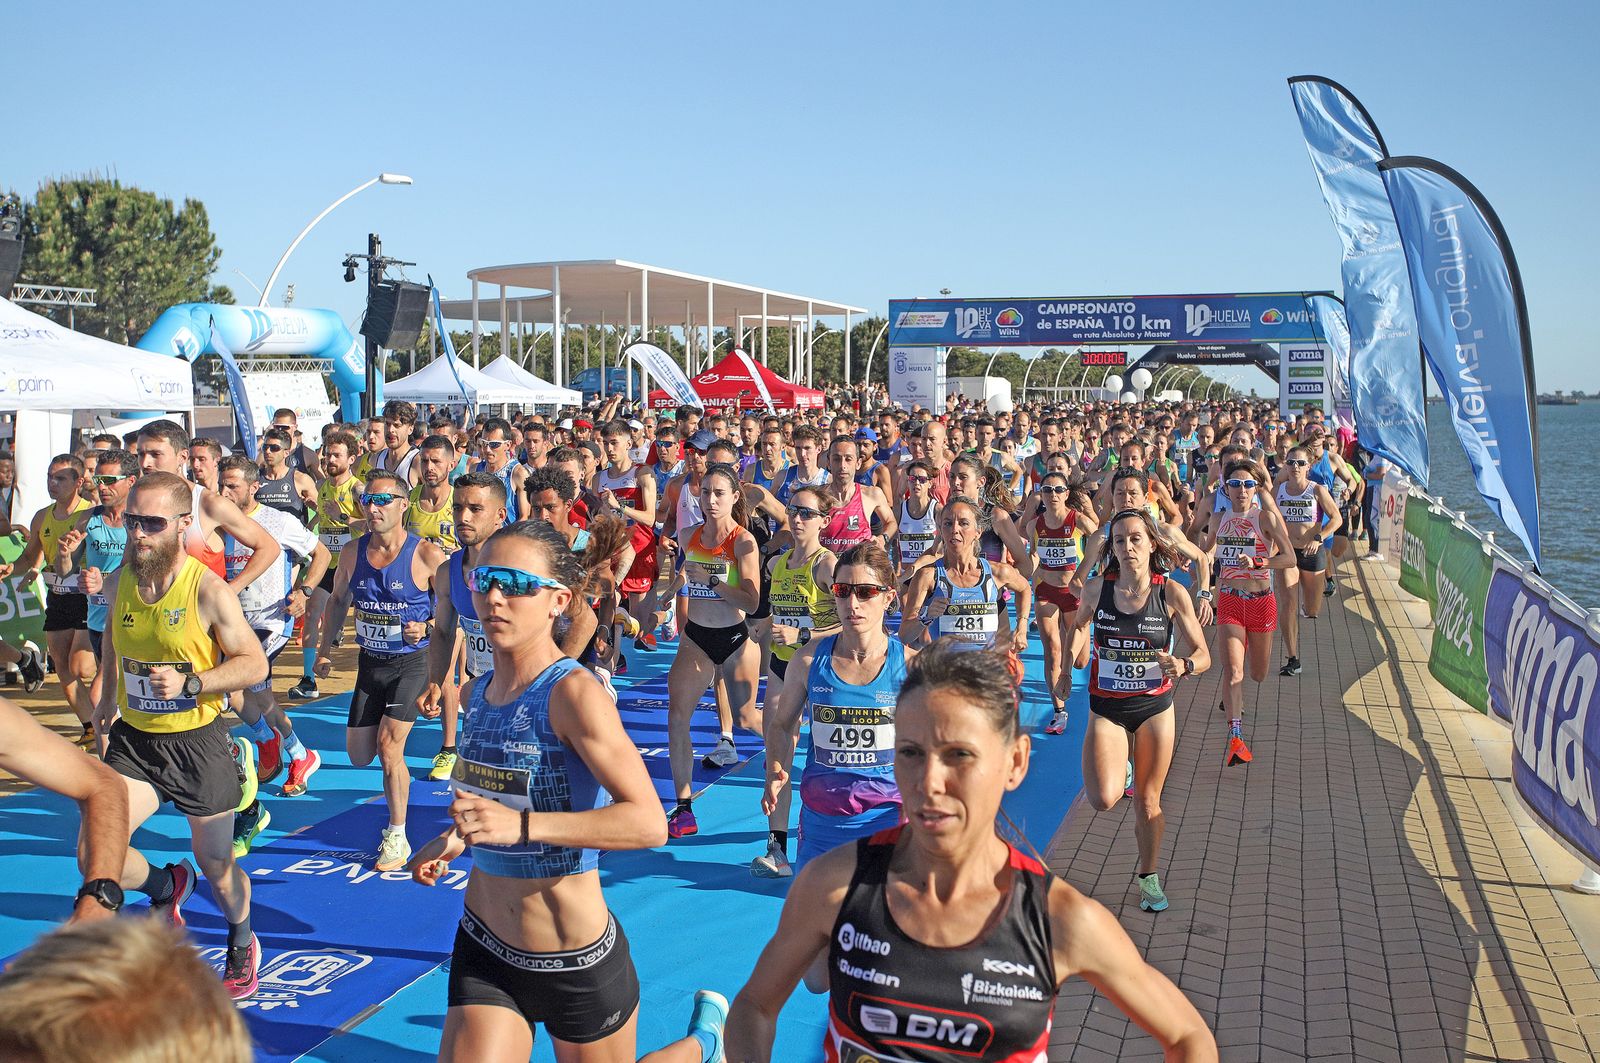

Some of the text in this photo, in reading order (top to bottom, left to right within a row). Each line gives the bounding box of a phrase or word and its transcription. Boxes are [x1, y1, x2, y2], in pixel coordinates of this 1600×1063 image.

[1037, 302, 1136, 314] CAMPEONATO
[1209, 308, 1251, 322] HUELVA
[1286, 311, 1316, 323] WiH
[272, 315, 310, 335] HUELVA
[1037, 314, 1172, 331] de ESPAÑA 10 km
[1084, 331, 1100, 339] ruta
[1101, 330, 1135, 338] Absoluto
[1290, 351, 1323, 361] Joma
[1290, 384, 1322, 394] Joma
[1286, 508, 1304, 516] 490
[328, 535, 339, 545] 76
[908, 542, 925, 551] 501
[1045, 548, 1066, 558] 483
[1222, 547, 1244, 557] 477
[954, 617, 984, 631] 481
[362, 625, 387, 639] 174
[1122, 640, 1145, 649] BM
[1114, 664, 1146, 679] 489
[1112, 680, 1148, 690] Joma
[138, 699, 179, 710] Joma
[829, 727, 876, 748] 499
[828, 751, 878, 765] Joma
[469, 764, 514, 781] RUNNING
[479, 780, 505, 791] LOOP
[837, 922, 891, 956] Bilbao
[481, 932, 565, 970] new balance
[576, 946, 605, 966] new
[838, 958, 901, 988] Guedan
[905, 1013, 979, 1047] BM
